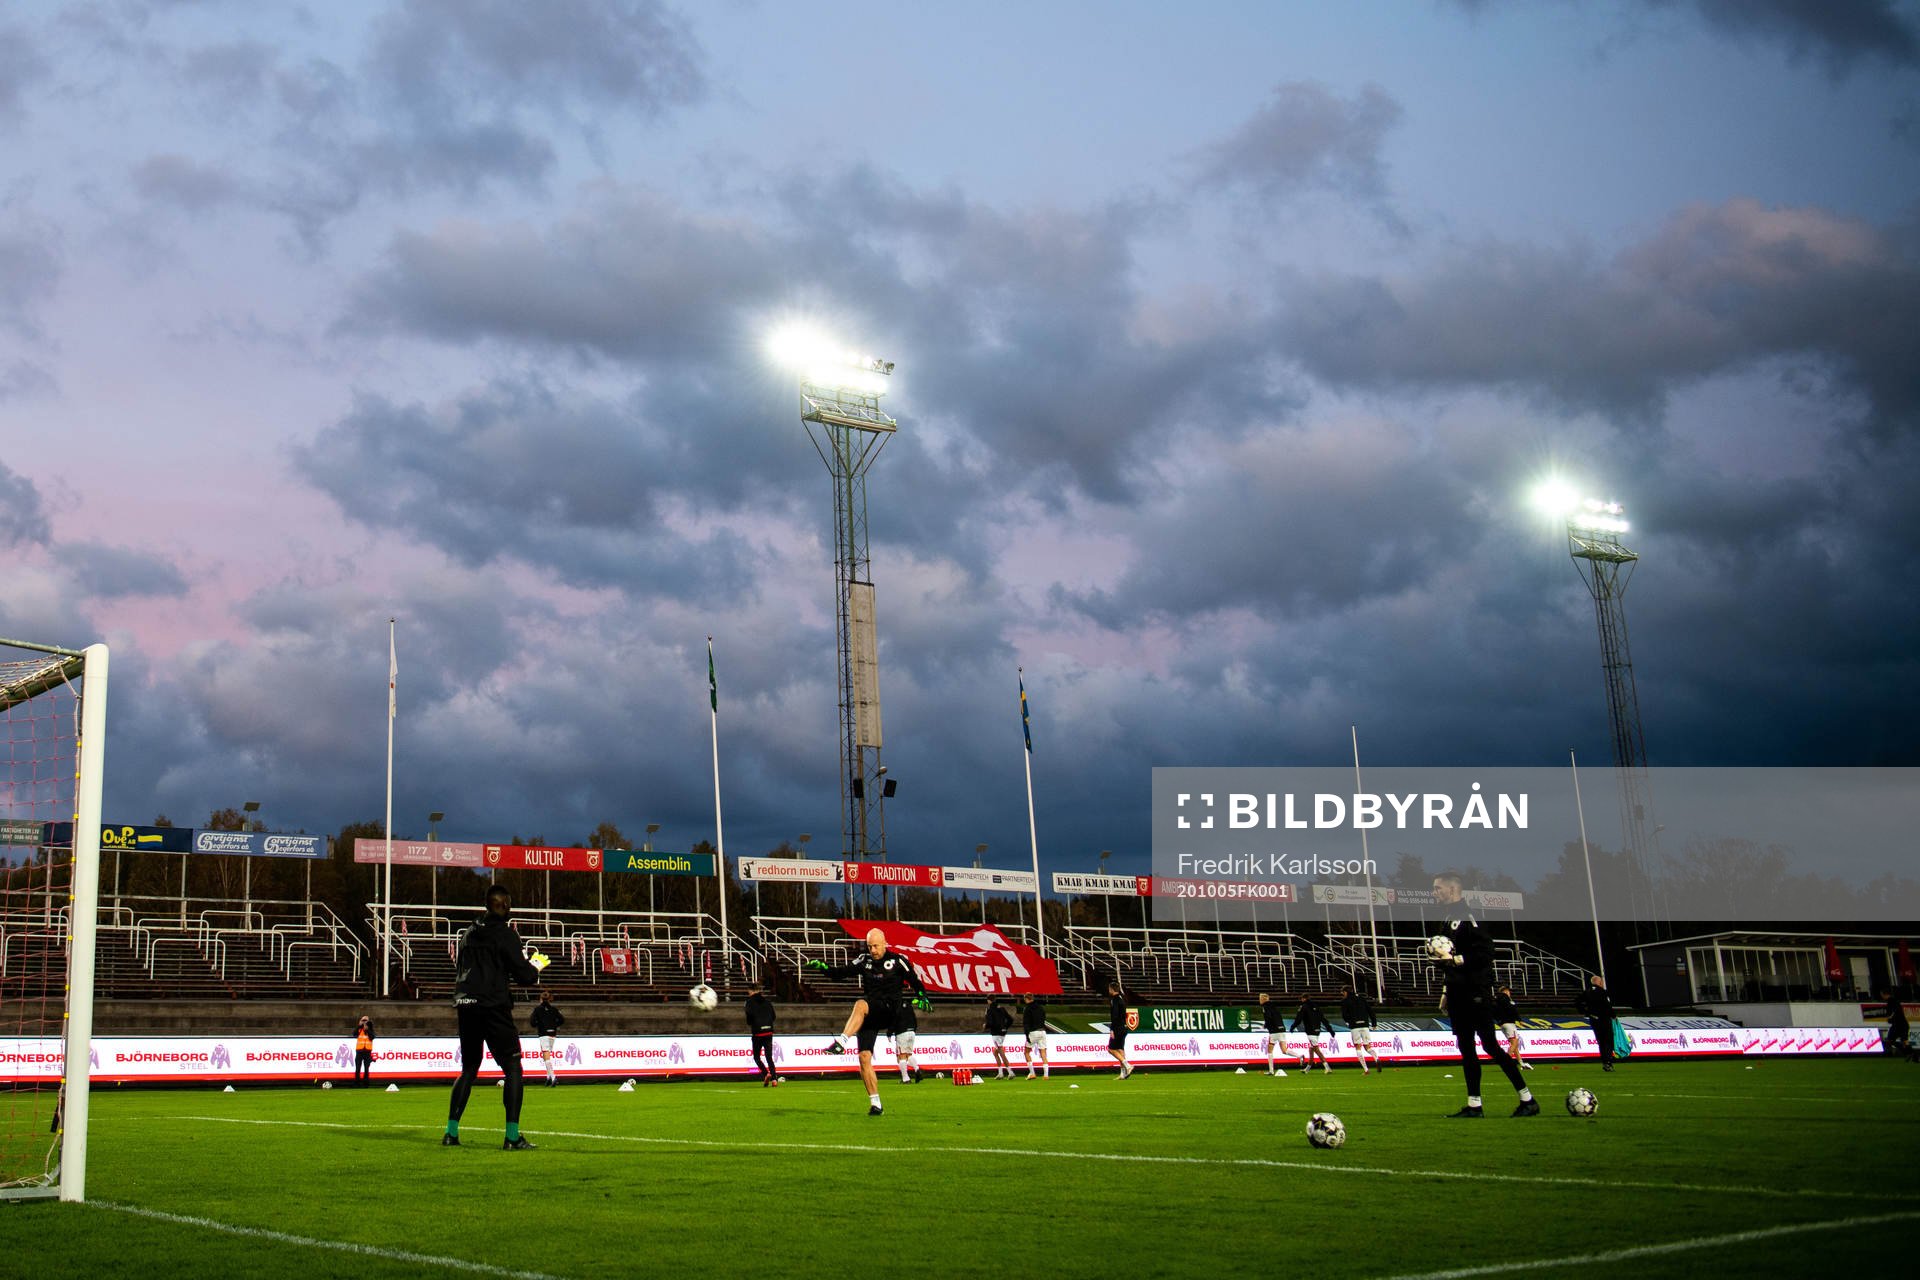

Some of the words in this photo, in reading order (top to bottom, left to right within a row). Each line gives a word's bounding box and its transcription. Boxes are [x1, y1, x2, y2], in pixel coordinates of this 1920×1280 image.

[408, 846, 428, 855] 1177
[525, 850, 563, 866] KULTUR
[627, 855, 691, 871] Assemblin
[757, 864, 797, 877] redhorn
[800, 866, 829, 877] music
[872, 866, 916, 882] TRADITION
[955, 873, 990, 881] PARTNERTECH
[1002, 875, 1035, 884] PARTNERTECH
[1057, 877, 1082, 887] KMAB
[1085, 878, 1110, 888] KMAB
[1113, 880, 1137, 890] KMAB
[912, 961, 1013, 993] RUKET
[1153, 1009, 1225, 1031] SUPERETTAN
[1056, 1043, 1109, 1052] BJÖRNEBOR
[116, 1050, 208, 1062] BJÖRNEBORG
[246, 1050, 334, 1061] BJÖRNEBORG
[371, 1049, 453, 1061] BJÖRNEBORG
[594, 1049, 668, 1059] BJÖRNEBORG
